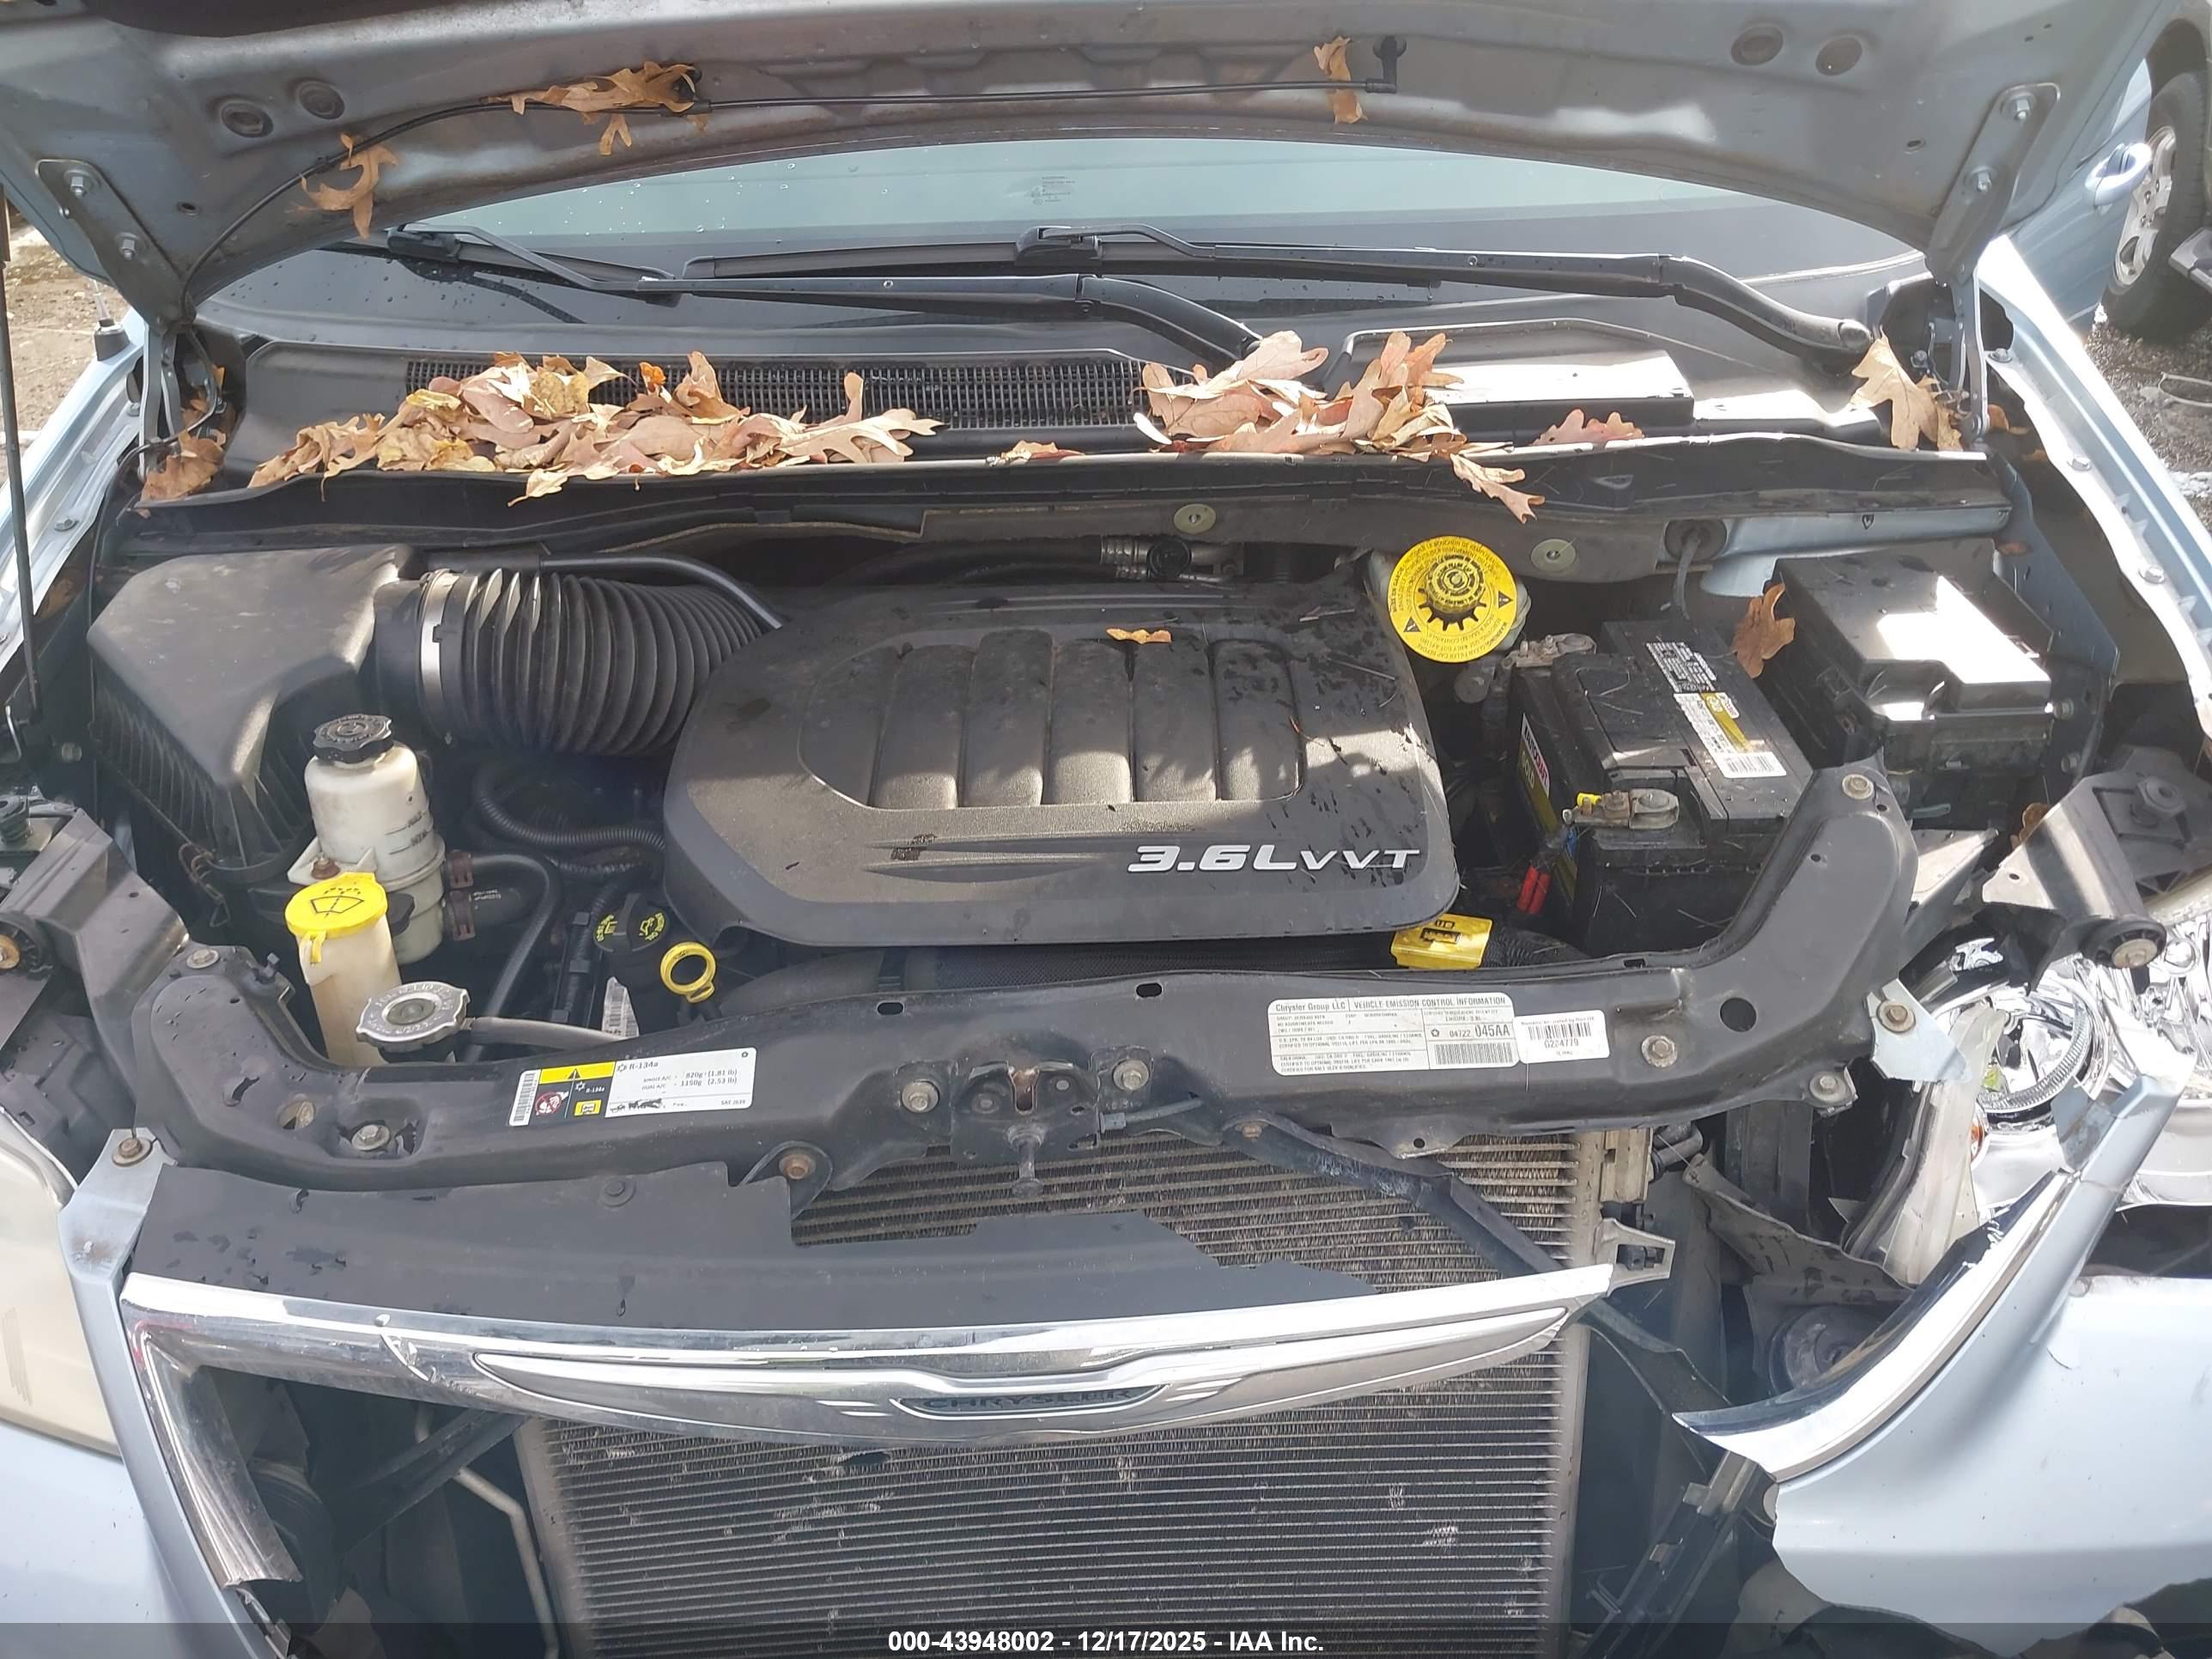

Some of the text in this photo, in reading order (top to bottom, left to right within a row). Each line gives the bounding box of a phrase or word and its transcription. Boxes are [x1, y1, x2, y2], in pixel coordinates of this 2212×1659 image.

[1127, 844, 1420, 873] 3.6L VVT
[1275, 1002, 1346, 1014] Chrysler Group LLC
[1353, 996, 1506, 1010] VEHICLE EMISSION CONTROL INFORMATION
[1449, 1024, 1511, 1038] 04722 045AA
[629, 1061, 659, 1071] R-134a
[680, 1079, 702, 1088] 1150g
[921, 1388, 1133, 1412] CHRYSLER
